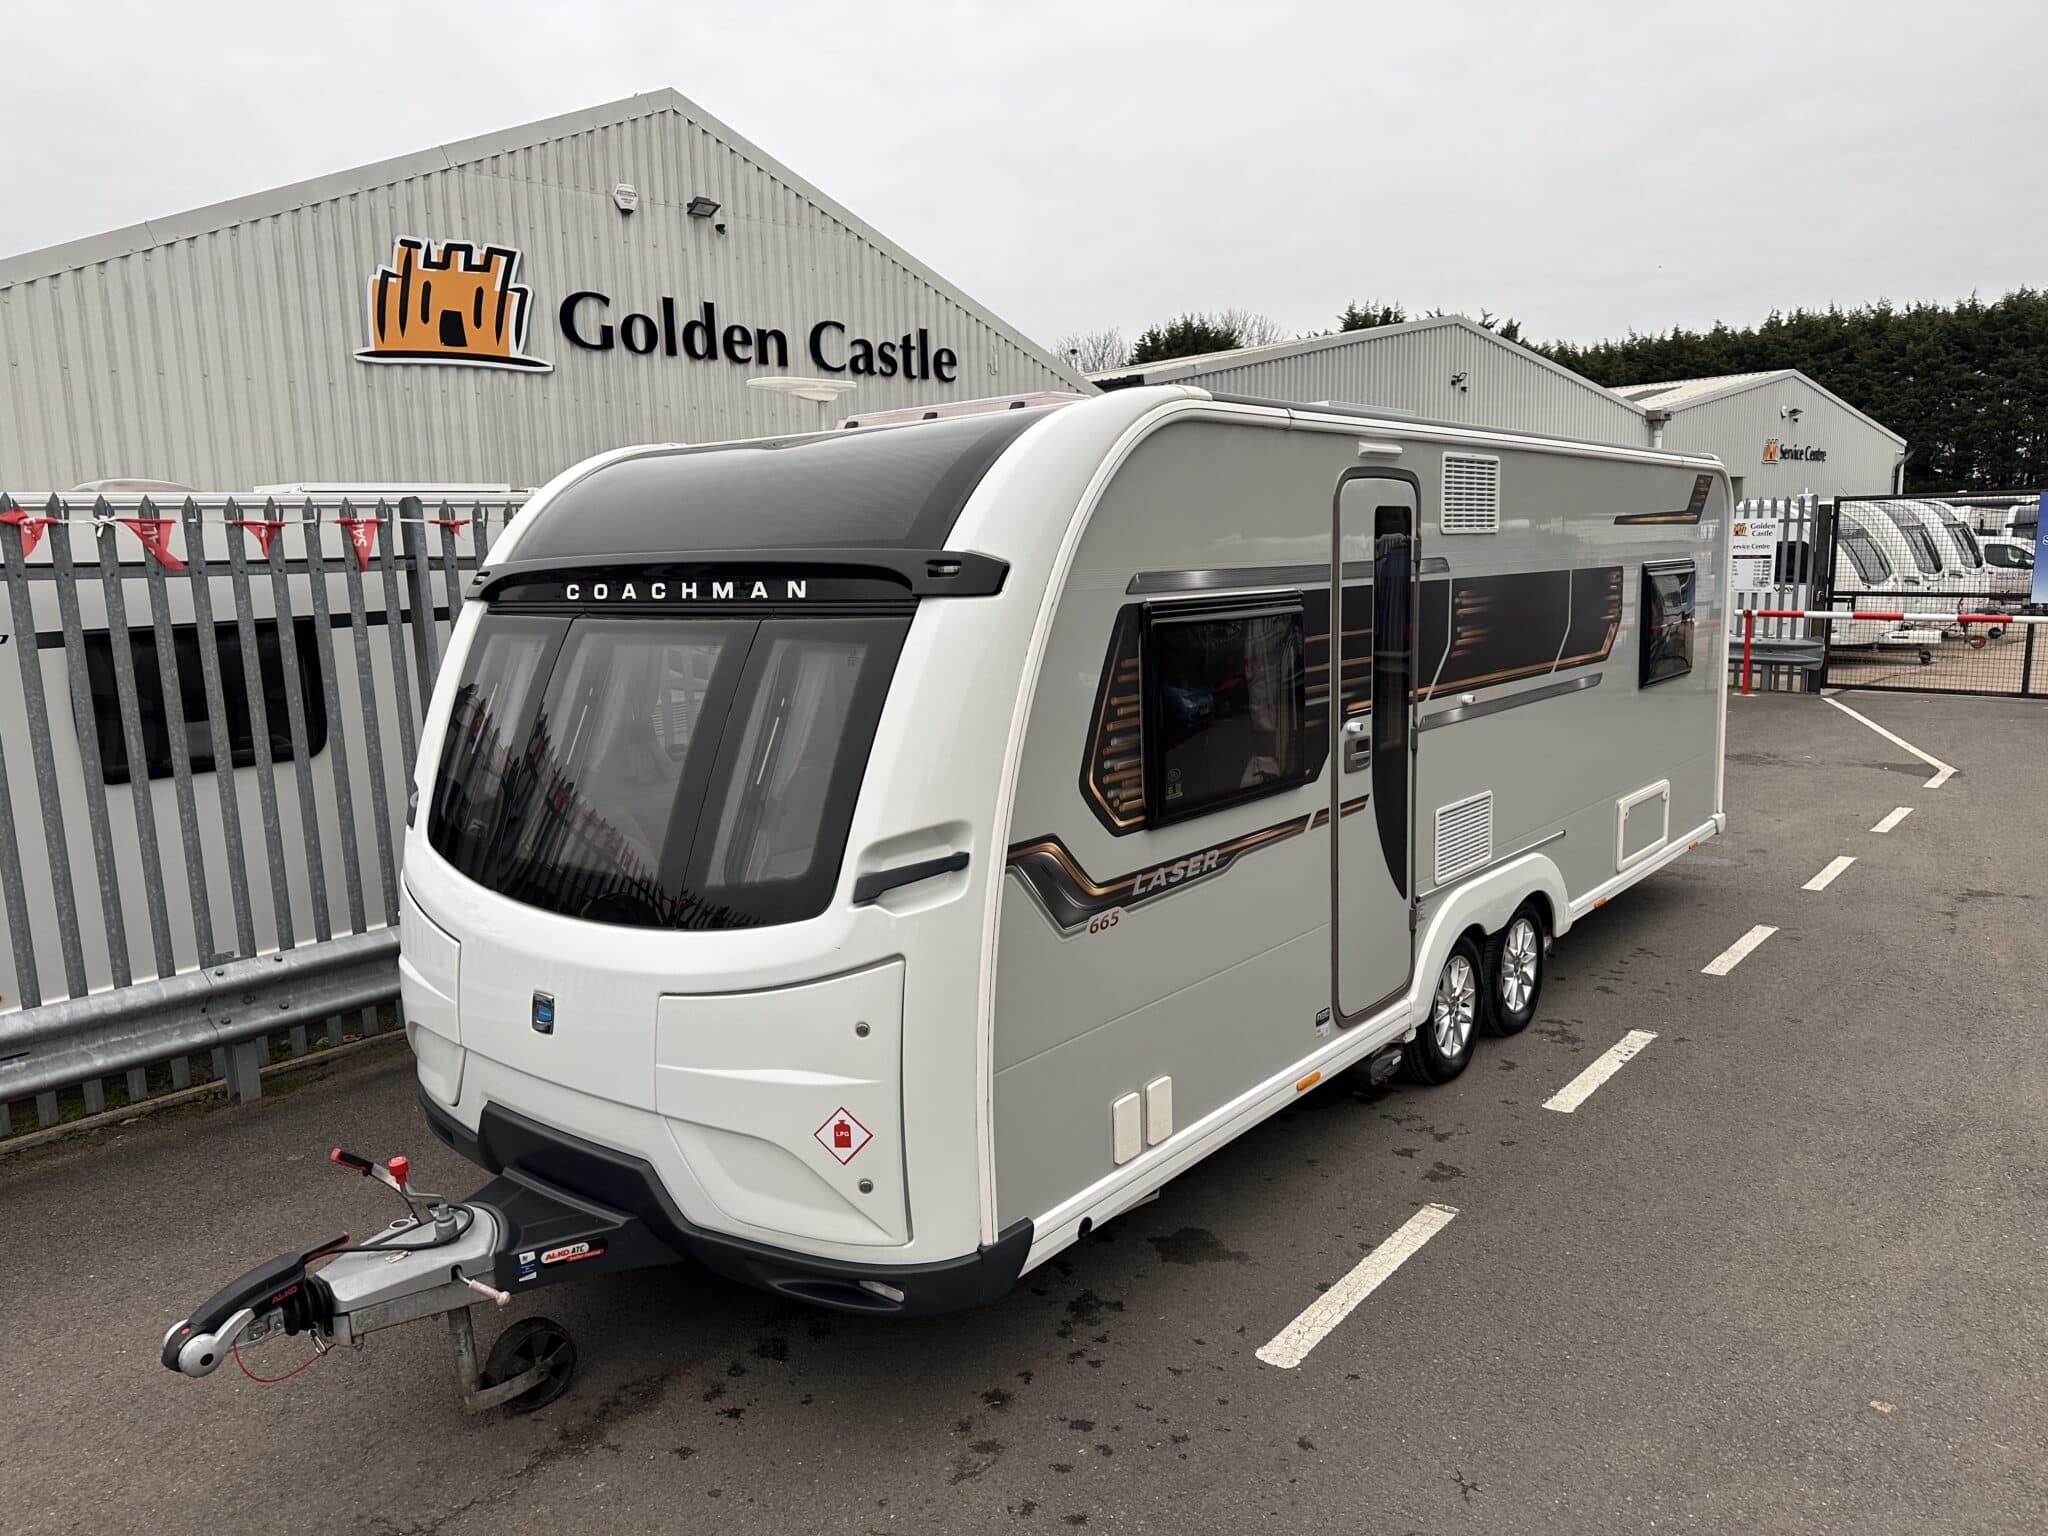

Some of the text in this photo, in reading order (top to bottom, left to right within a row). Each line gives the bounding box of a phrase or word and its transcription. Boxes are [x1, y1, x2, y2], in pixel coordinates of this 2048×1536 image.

[559, 290, 958, 383] Golden Castle
[1780, 443, 1827, 462] Service Centre
[1750, 522, 1776, 530] Golden
[566, 579, 807, 600] COACHMAN
[1131, 849, 1221, 897] LASER
[1088, 910, 1120, 935] 665
[570, 1244, 585, 1254] ATC
